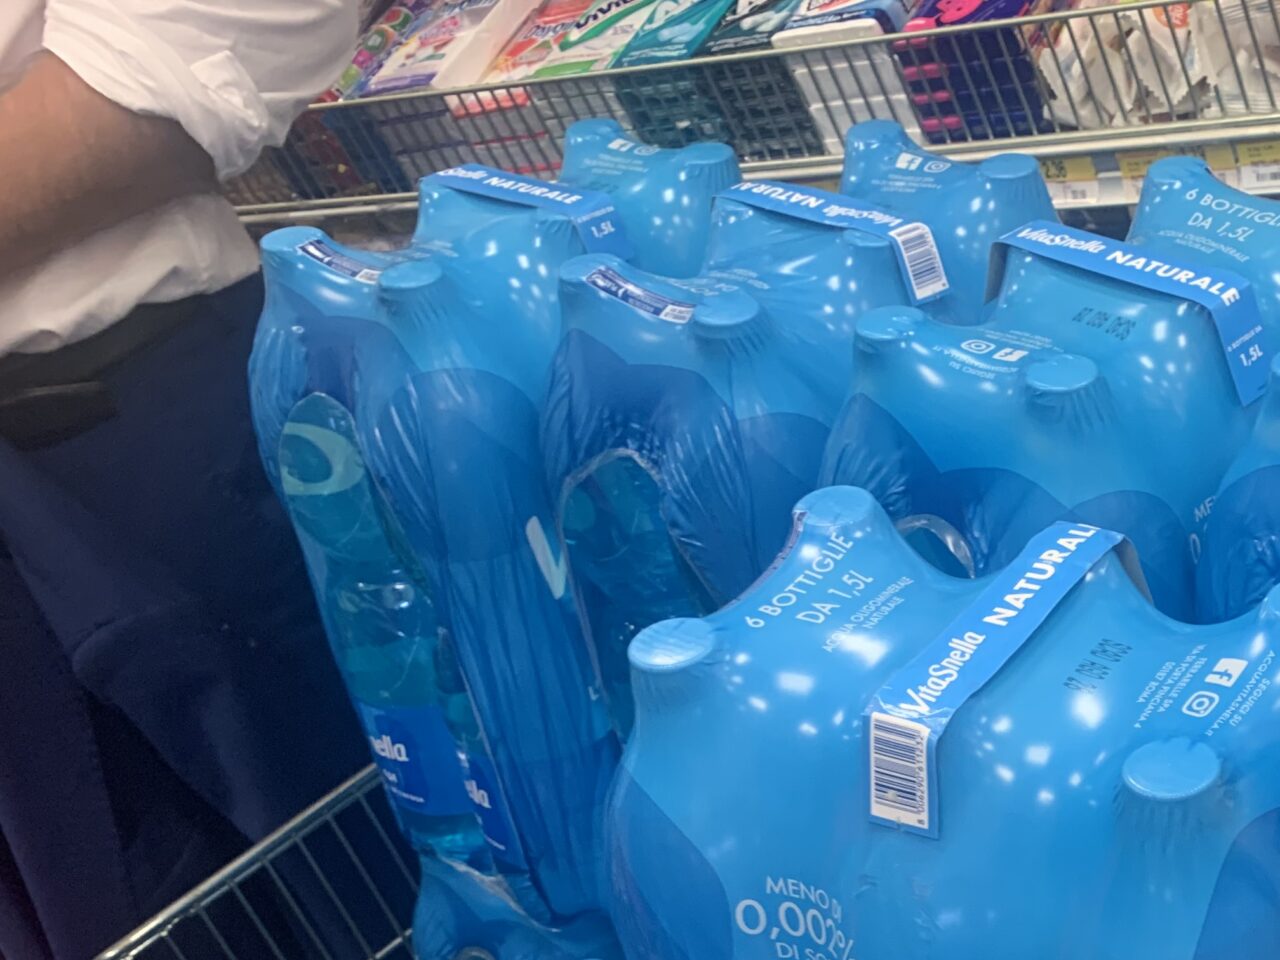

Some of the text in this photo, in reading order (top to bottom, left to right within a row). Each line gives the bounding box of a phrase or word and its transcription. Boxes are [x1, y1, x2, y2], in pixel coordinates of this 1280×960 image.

[483, 176, 583, 204] NATURALE
[731, 182, 825, 208] NATURA
[1184, 187, 1200, 201] 6
[1187, 211, 1255, 243] DA 1,5L
[1016, 226, 1241, 307] VitaSnella NATURALE
[1239, 343, 1264, 367] 1,5L
[744, 531, 854, 629] 6 BOTTIGLIE
[795, 569, 874, 625] DA 1,5L
[861, 596, 905, 630] NATURALE
[897, 523, 1101, 718] VitaSnella NATURAL
[765, 875, 830, 909] MENO
[775, 942, 801, 960] DI
